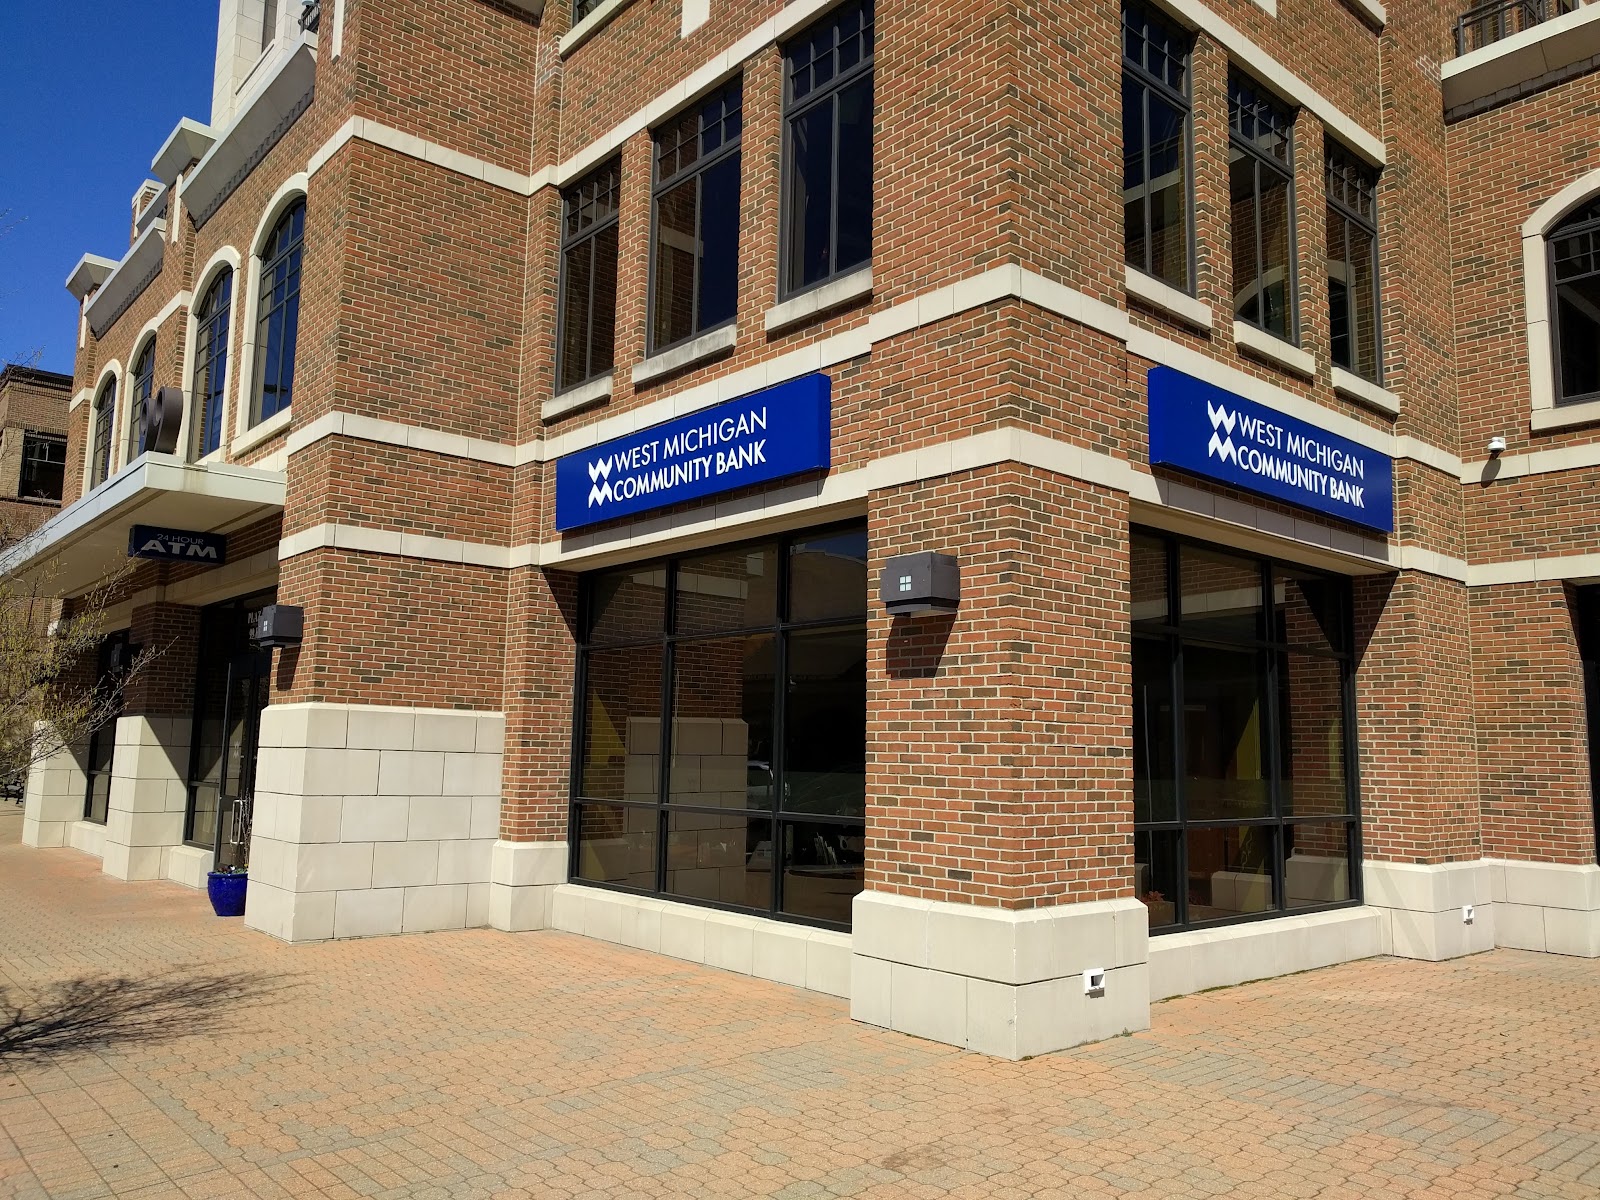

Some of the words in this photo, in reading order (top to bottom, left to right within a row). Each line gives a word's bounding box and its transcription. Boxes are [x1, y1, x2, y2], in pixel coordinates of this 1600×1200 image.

[613, 454, 713, 502] COMMUNITY
[716, 439, 767, 475] BANK
[614, 441, 660, 473] WEST
[663, 406, 767, 460] MICHIGAN
[1238, 412, 1284, 450] WEST
[1286, 431, 1364, 480] MICHIGAN
[1238, 445, 1328, 496] COMMUNITY
[1329, 476, 1365, 509] BANK
[140, 539, 218, 559] ATM
[157, 533, 169, 541] 24
[172, 535, 204, 545] HOUR
